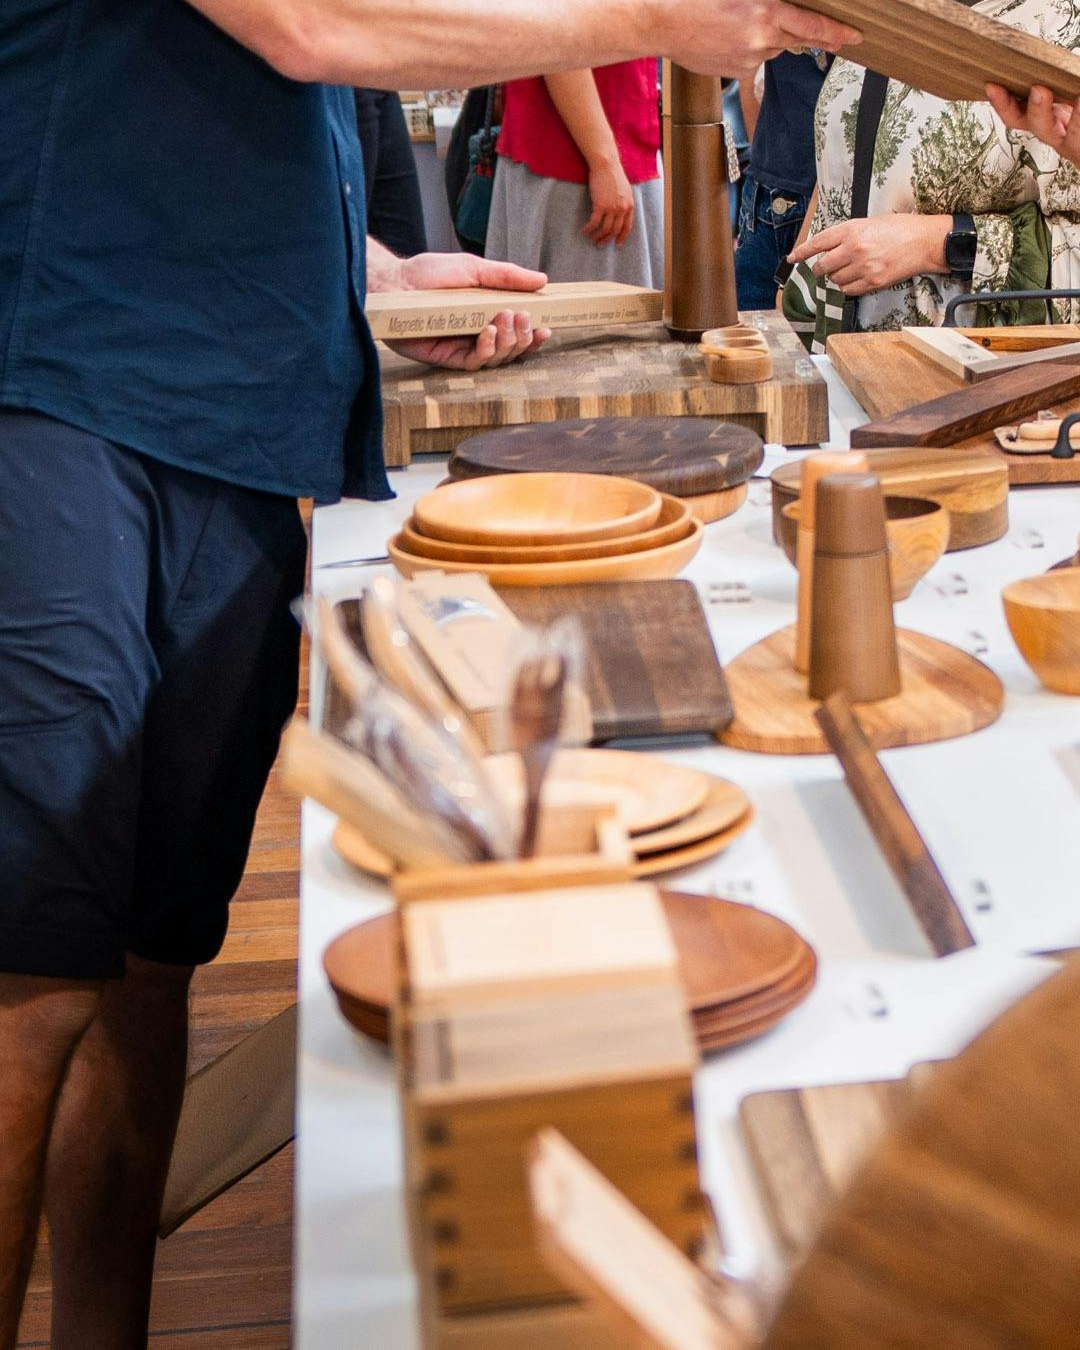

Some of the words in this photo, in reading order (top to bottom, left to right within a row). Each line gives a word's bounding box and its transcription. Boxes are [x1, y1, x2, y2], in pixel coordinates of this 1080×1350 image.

[388, 317, 424, 335] Magnetic
[427, 315, 446, 331] Knife
[447, 313, 467, 329] Rack
[469, 312, 485, 328] 370
